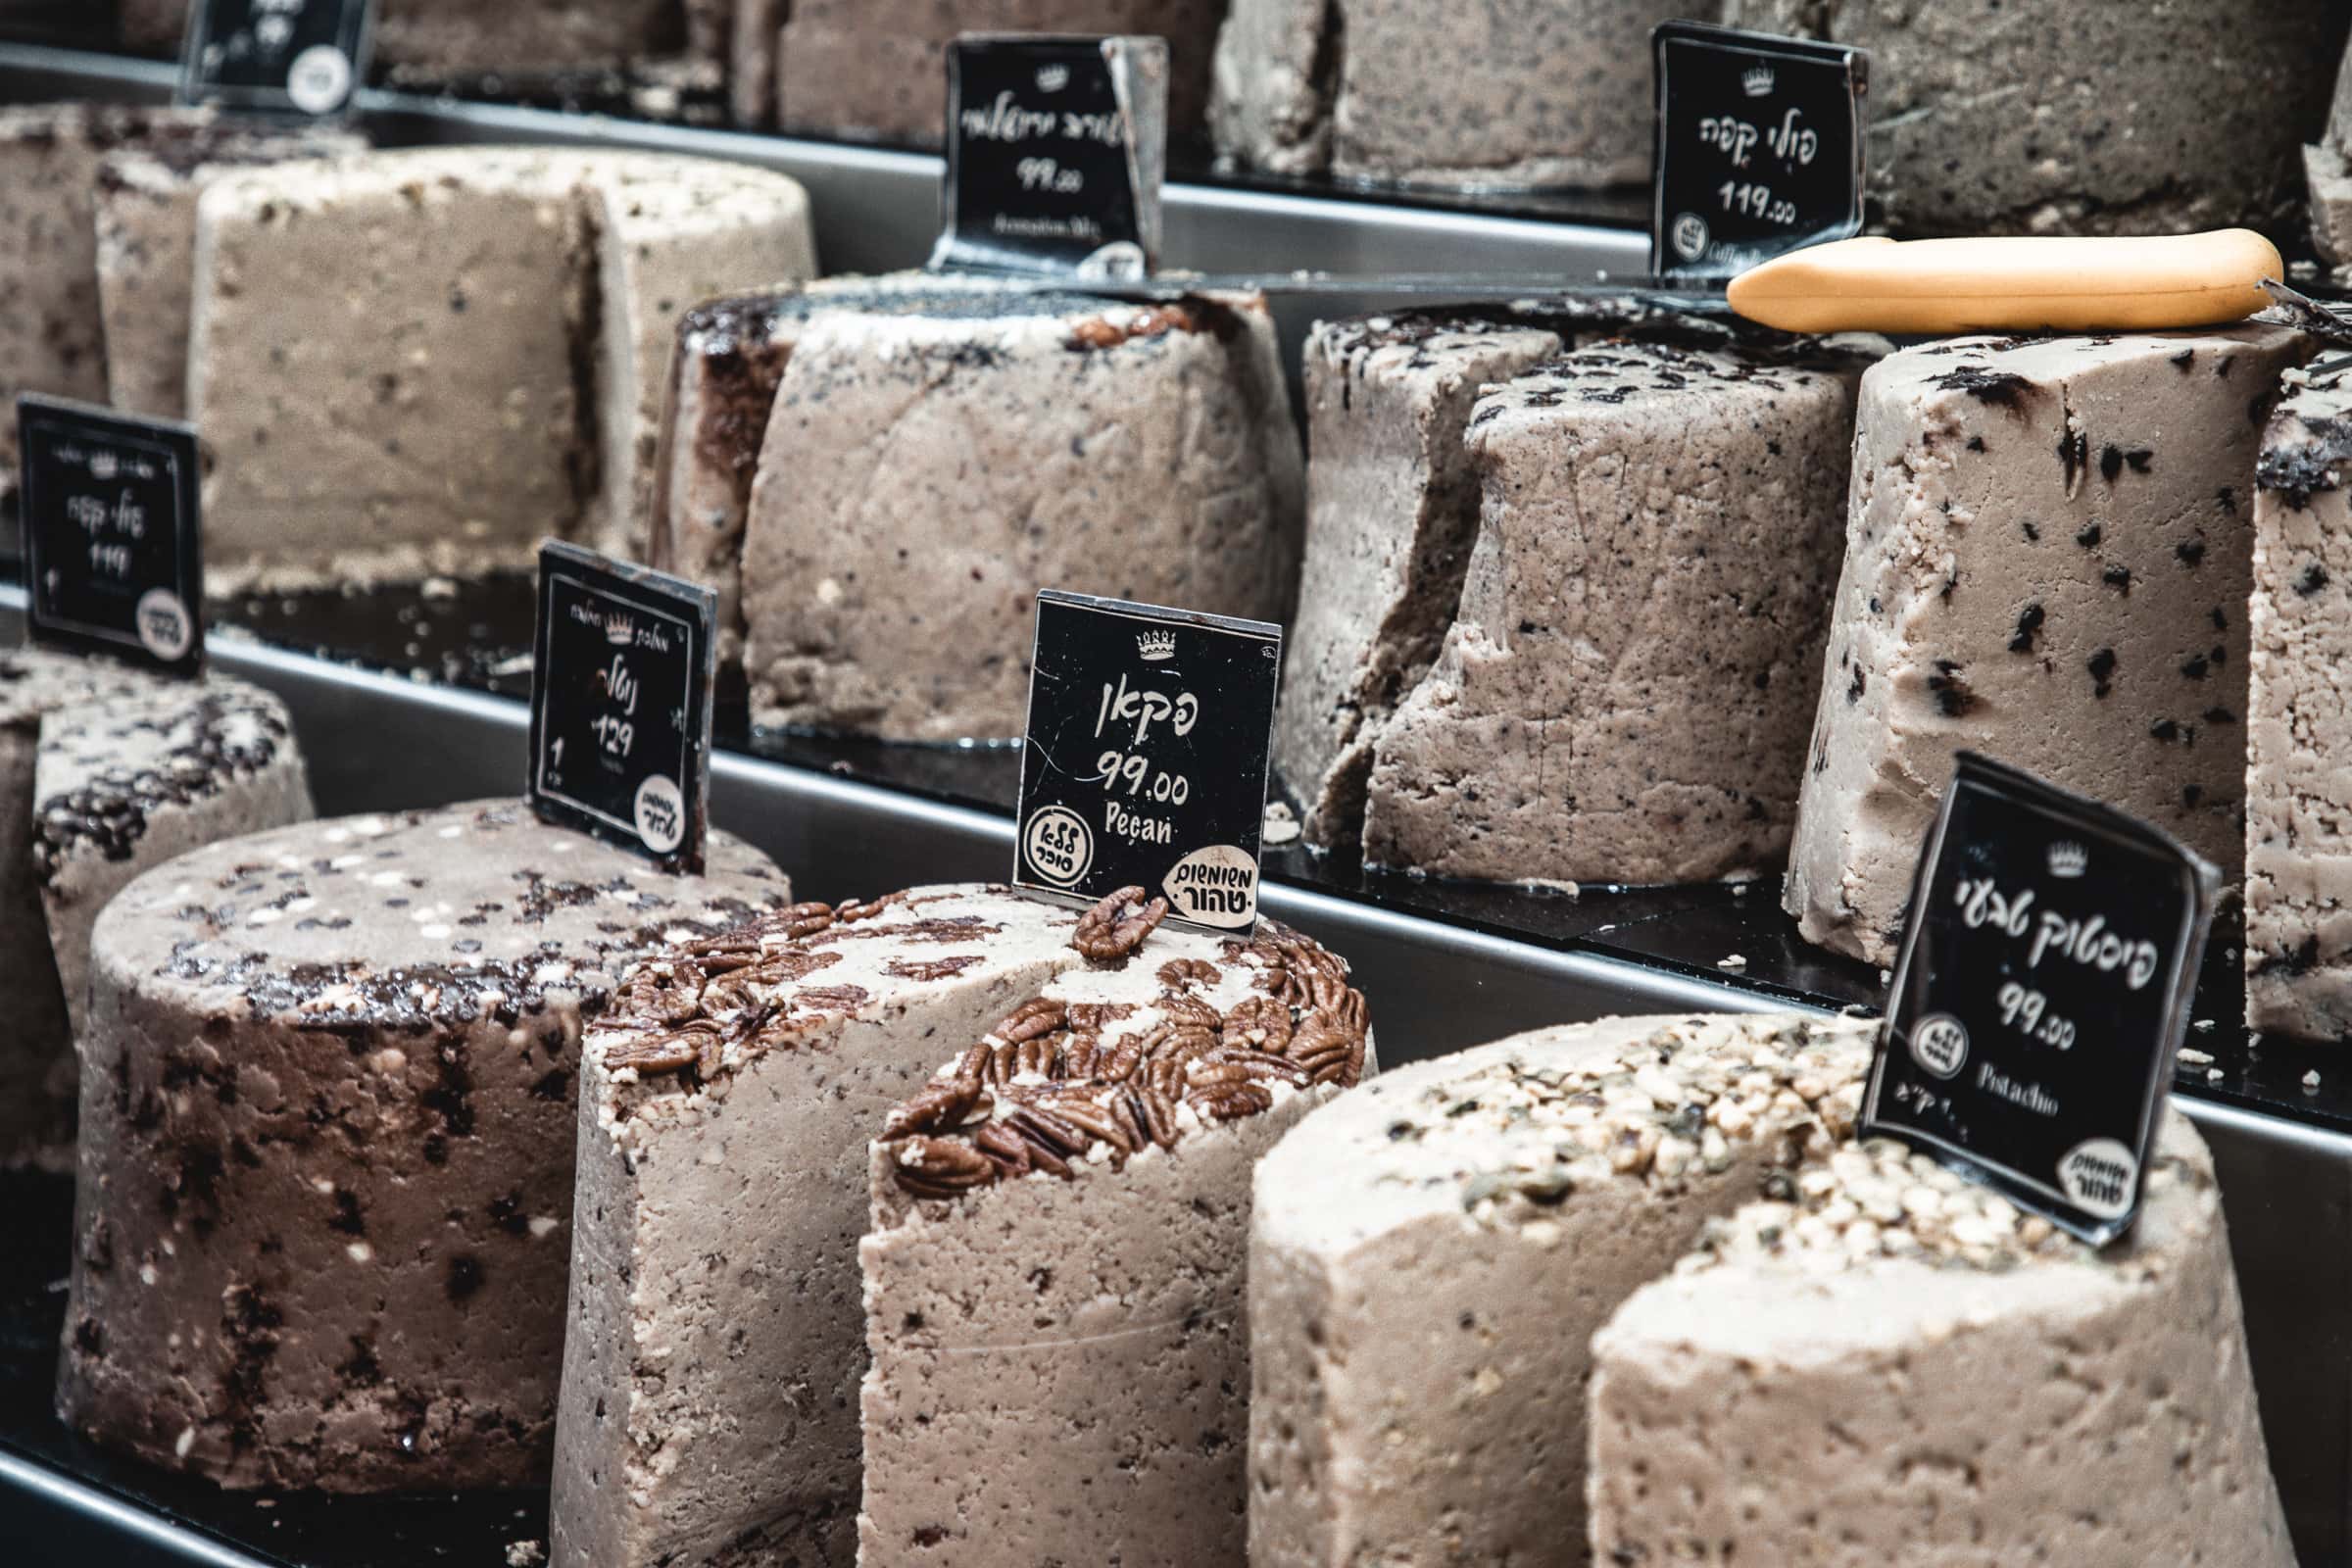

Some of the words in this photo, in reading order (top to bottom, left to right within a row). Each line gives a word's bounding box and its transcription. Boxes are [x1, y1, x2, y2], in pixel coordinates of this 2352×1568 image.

[1698, 116, 1759, 166] קפה
[1767, 108, 1817, 165] פולי
[1718, 180, 1795, 224] 119.00
[1095, 672, 1199, 746] פקאן
[596, 713, 634, 757] 129
[1097, 751, 1189, 806] 99.00
[1041, 821, 1079, 855] ללא
[1105, 802, 1172, 844] Pecan
[1036, 846, 1073, 872] סוכר
[1174, 863, 1252, 888] משומשום
[1183, 886, 1247, 914] טהור
[1954, 876, 2035, 937] טבעי
[2029, 911, 2158, 991] פיסטוק
[1997, 981, 2076, 1051] 99.00
[1977, 1061, 2059, 1117] Pistachio
